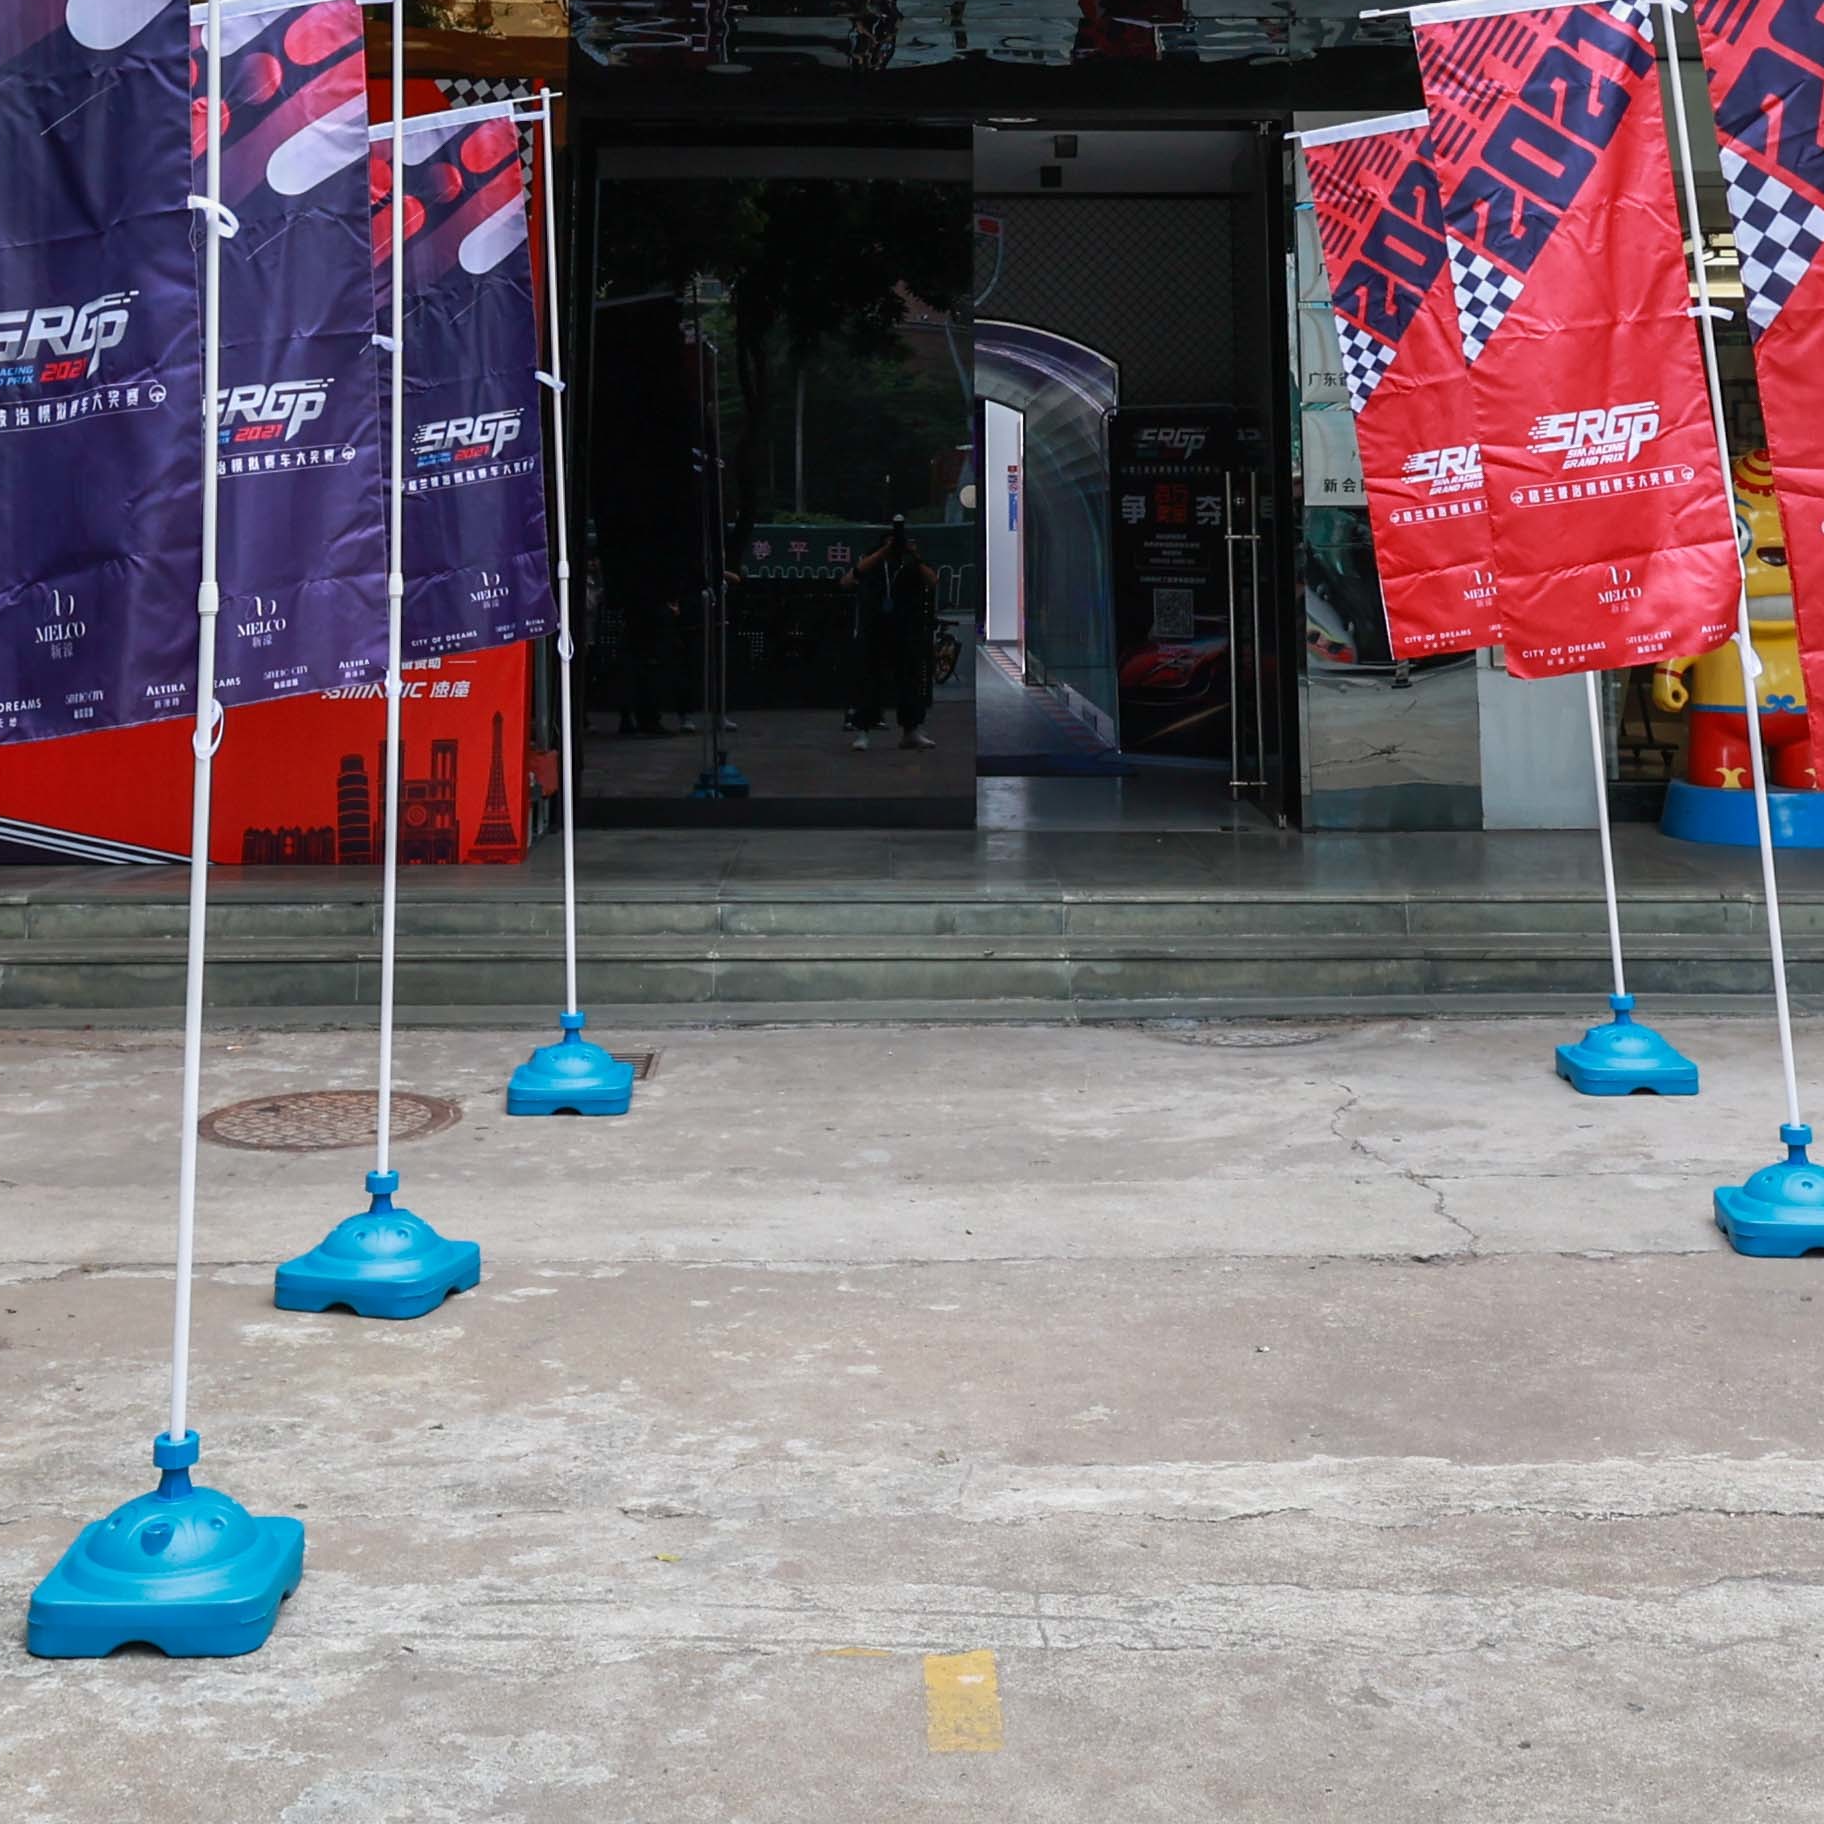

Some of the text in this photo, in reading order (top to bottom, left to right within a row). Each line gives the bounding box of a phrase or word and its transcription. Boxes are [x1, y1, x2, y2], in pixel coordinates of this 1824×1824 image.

[1444, 4, 1655, 274] 2021
[1331, 133, 1449, 345] 202
[5, 374, 35, 387] PRIX
[234, 423, 284, 443] 2021
[410, 407, 525, 459] SRGP
[1527, 400, 1660, 463] SRGP
[1562, 452, 1626, 470] GRAND PRIX
[1566, 442, 1626, 460] SIM RACING
[217, 448, 336, 476] 治模拟赛车大奖赛
[1597, 586, 1643, 605] MELCO
[35, 620, 86, 644] MELCO
[237, 618, 287, 638] MELCO
[1522, 641, 1607, 659] CITY OF DREAMS
[212, 676, 242, 689] EAMS
[321, 681, 428, 700] SIMAIC
